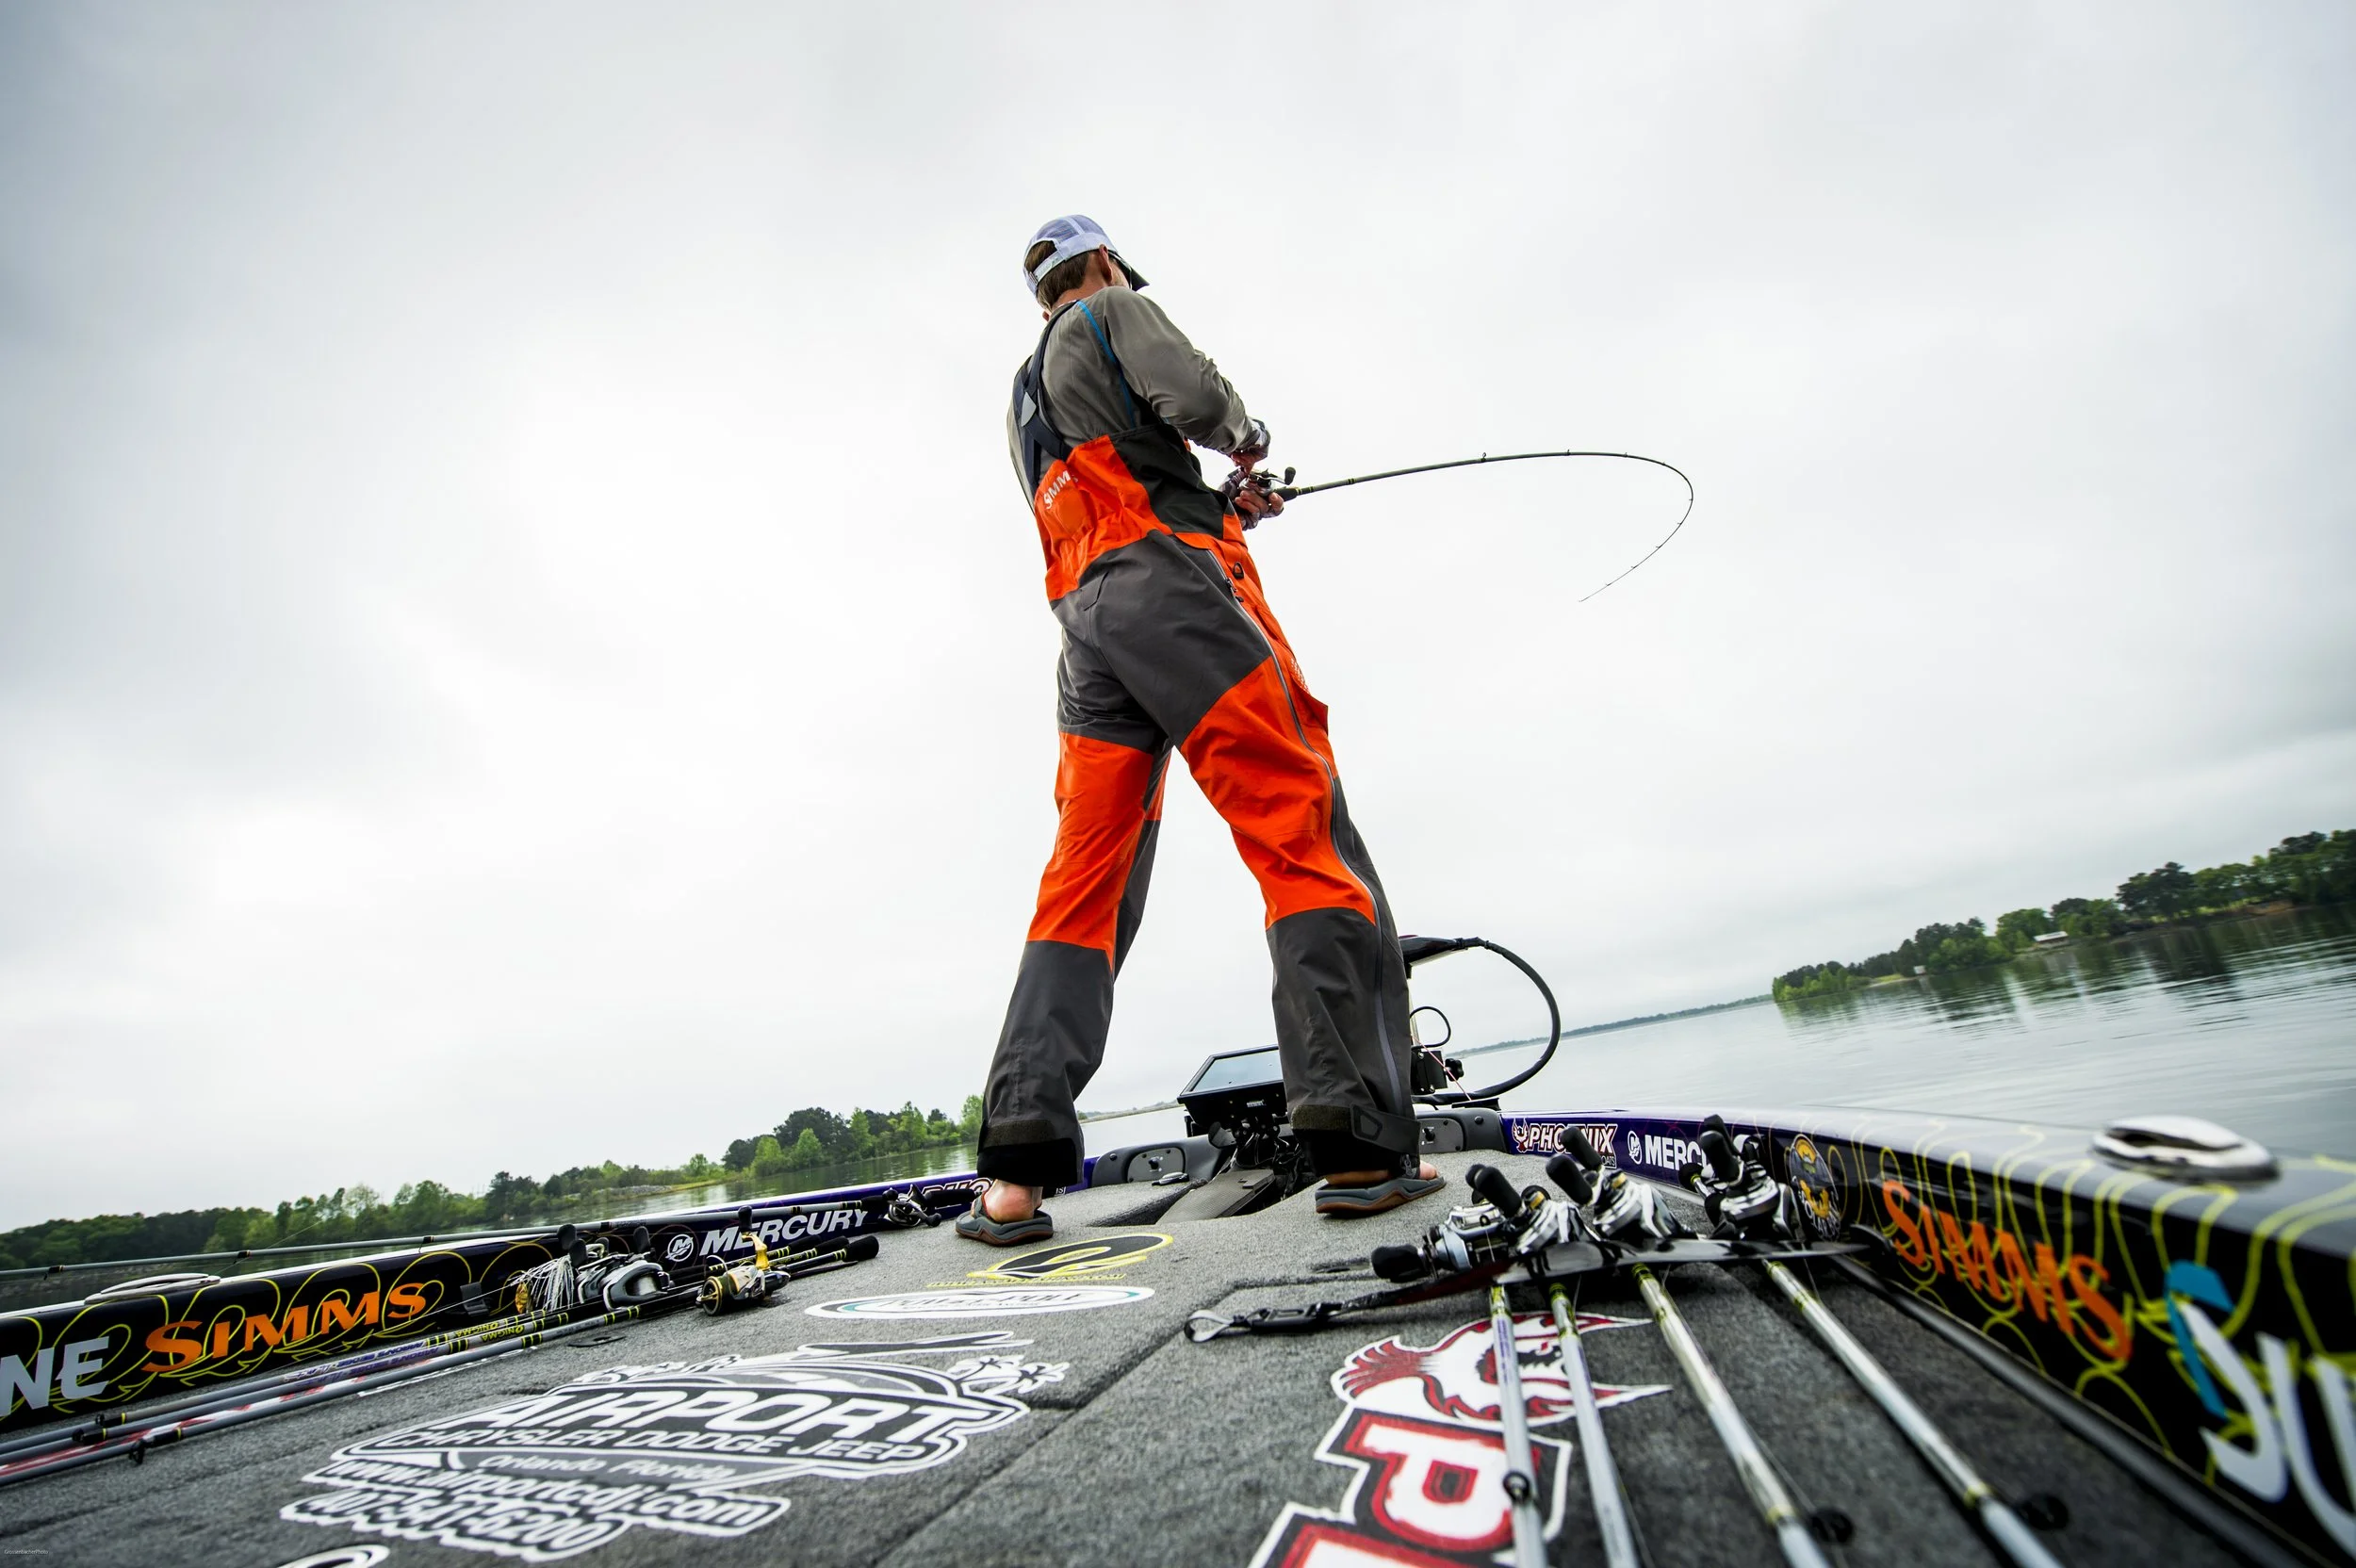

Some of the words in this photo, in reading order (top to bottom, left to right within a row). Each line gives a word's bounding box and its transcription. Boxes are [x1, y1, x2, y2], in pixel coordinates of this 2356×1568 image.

[1043, 469, 1079, 510] SIMM
[1529, 1124, 1617, 1154] PHONIX
[1644, 1135, 1707, 1170] MERC
[1882, 1180, 2133, 1361] SIMMS
[140, 1282, 428, 1373] SIMMS
[428, 1389, 992, 1444] AIRPORT
[377, 1429, 618, 1448] CHRYSLER
[624, 1429, 796, 1454] DODGE
[786, 1437, 927, 1461] JEEP
[477, 1454, 608, 1473] Orlando
[612, 1459, 739, 1481] Florida
[322, 1458, 770, 1527] www.airportcdj.com
[305, 1488, 612, 1550] 407-541-6200
